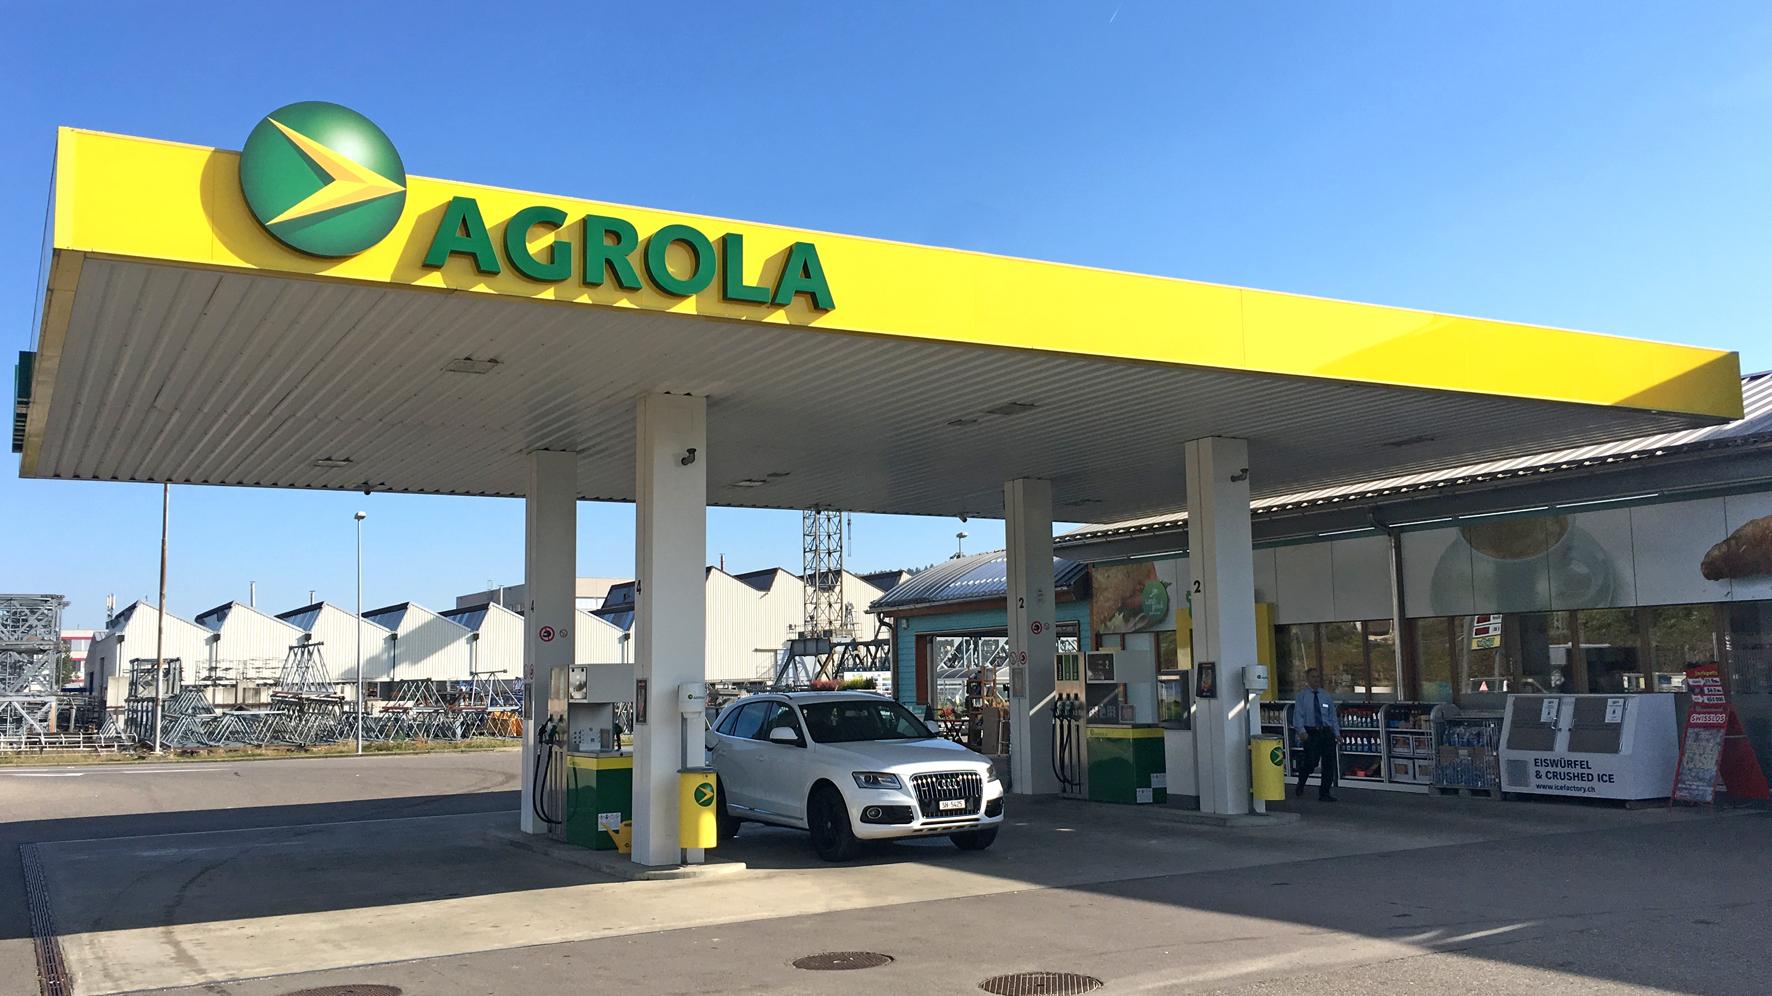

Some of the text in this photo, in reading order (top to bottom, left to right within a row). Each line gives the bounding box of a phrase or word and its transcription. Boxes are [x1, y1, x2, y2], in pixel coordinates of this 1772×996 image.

[422, 196, 835, 311] AGROLA
[636, 579, 642, 596] 4
[1193, 579, 1201, 594] 2
[1018, 596, 1025, 609] 2
[1690, 714, 1725, 723] SWISSLOS
[1534, 757, 1592, 770] EISWÜRFEL
[1534, 770, 1615, 784] & CRUSHED ICE
[1535, 783, 1596, 794] www.icefactory.ch
